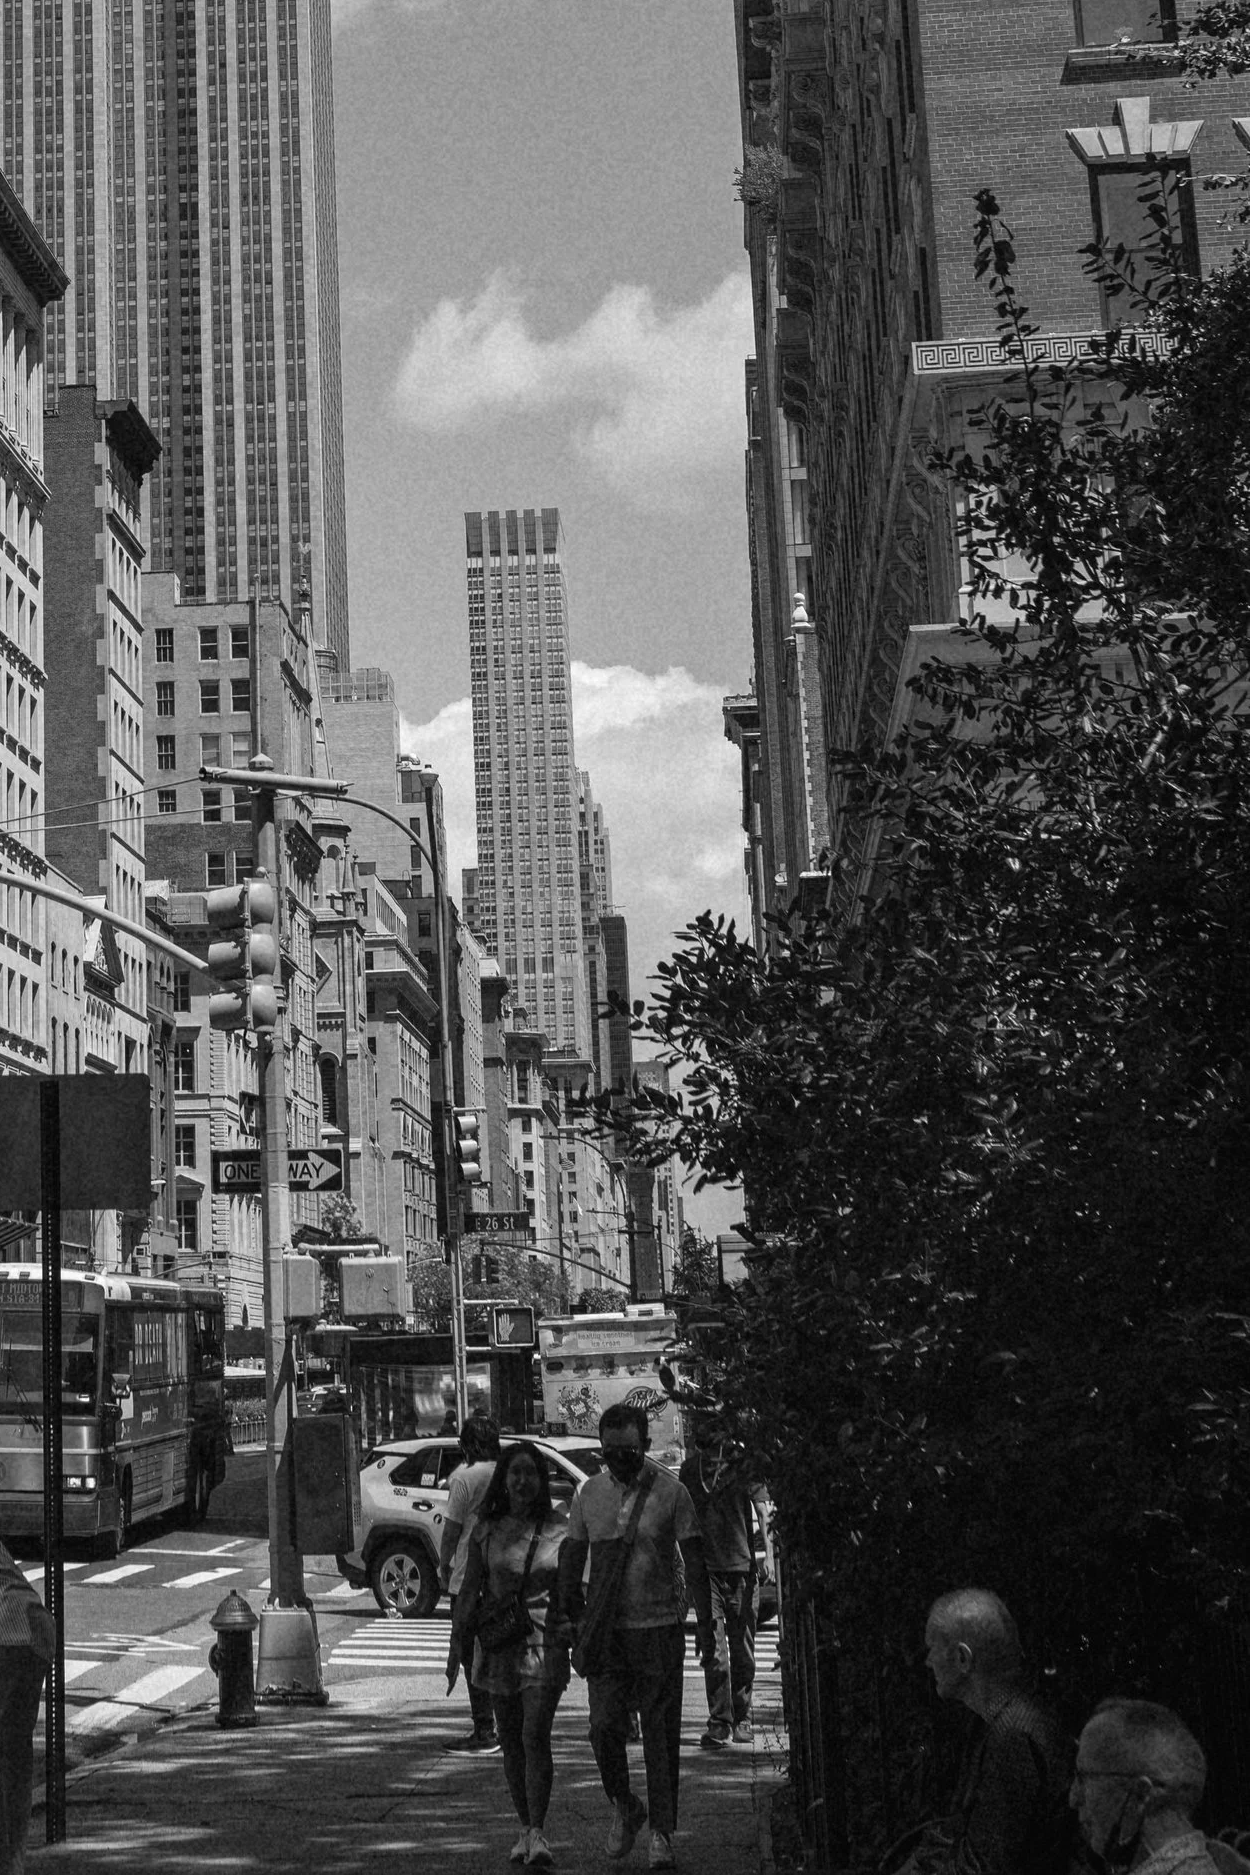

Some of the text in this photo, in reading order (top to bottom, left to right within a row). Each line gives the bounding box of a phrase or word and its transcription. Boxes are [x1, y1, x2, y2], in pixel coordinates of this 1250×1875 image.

[224, 1162, 325, 1180] ONE WAY
[485, 1217, 499, 1230] 26
[503, 1216, 515, 1230] St
[9, 1283, 42, 1294] MIDTO
